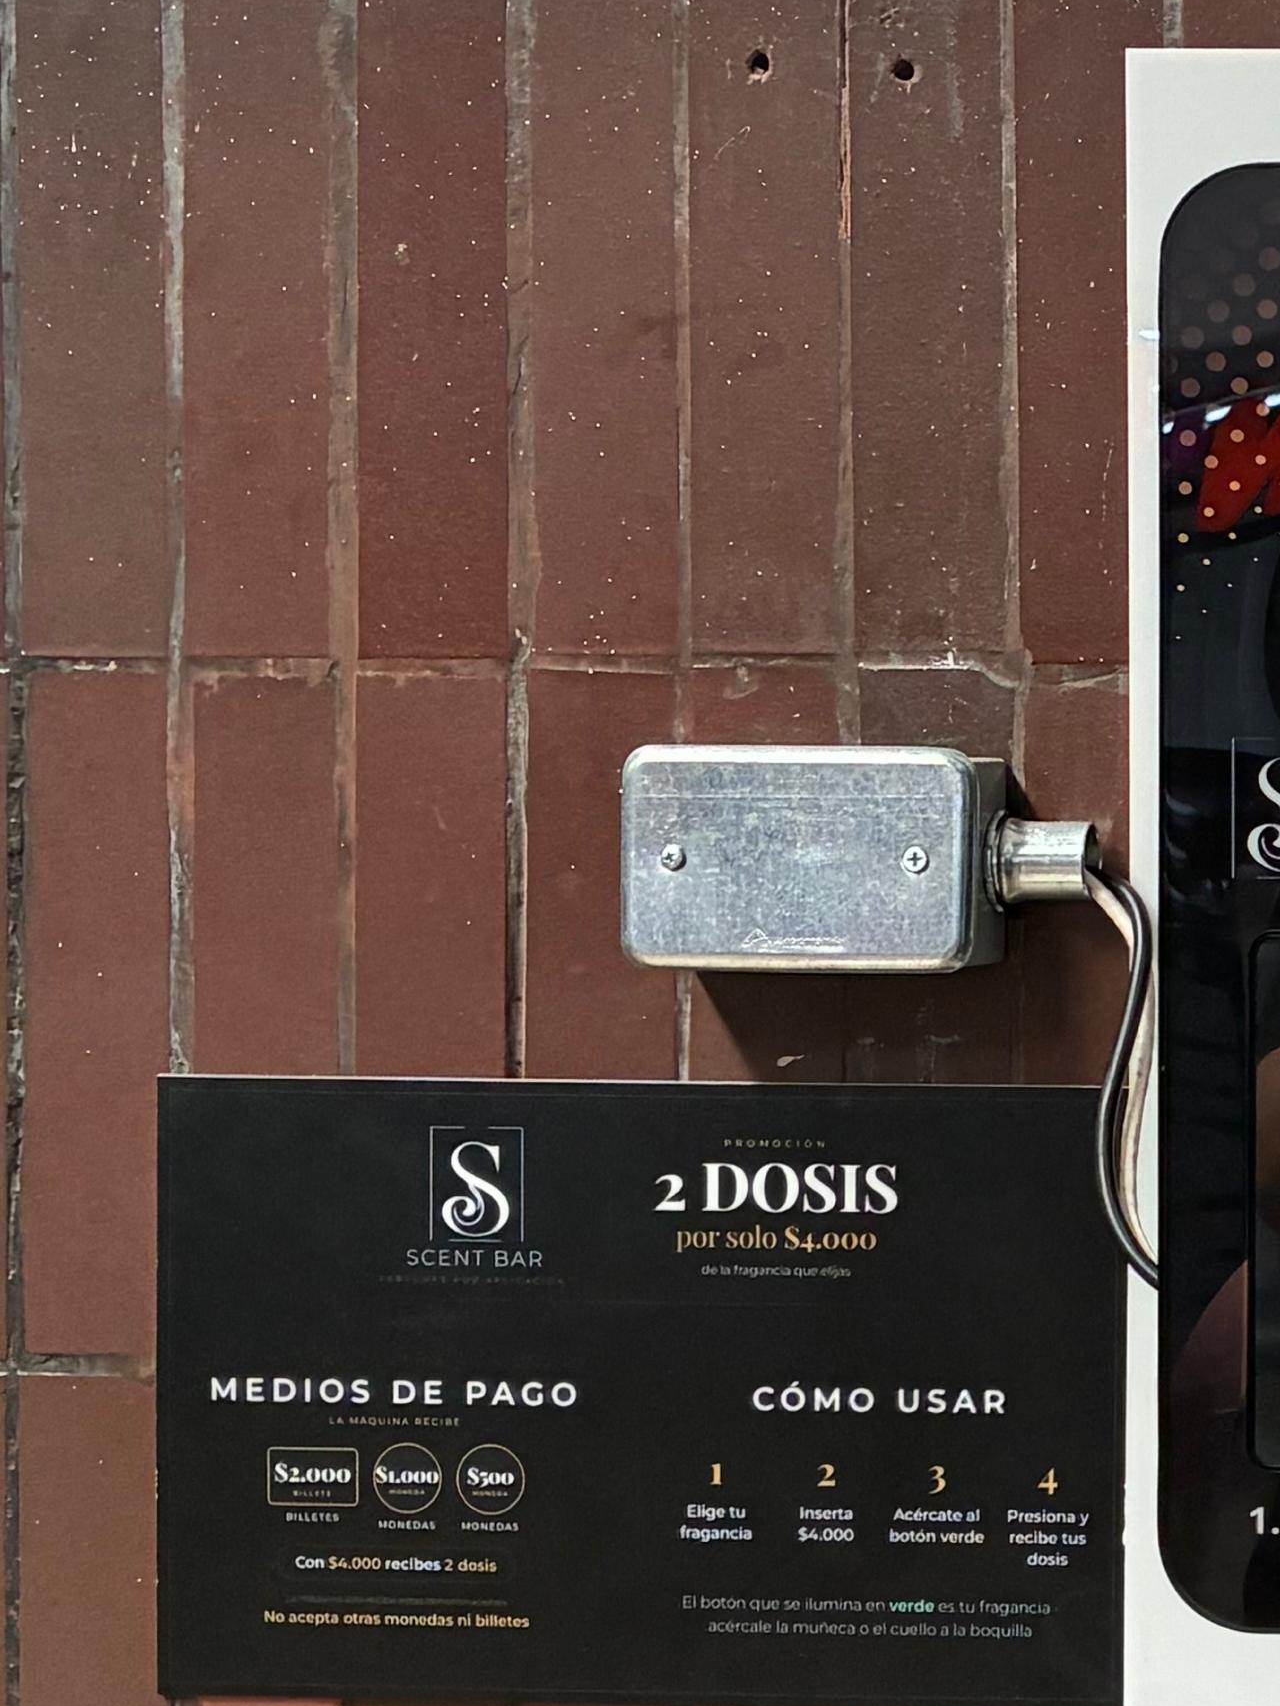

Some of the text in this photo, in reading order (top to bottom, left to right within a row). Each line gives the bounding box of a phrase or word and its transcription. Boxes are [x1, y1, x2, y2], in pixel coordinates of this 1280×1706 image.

[652, 1162, 899, 1214] 2 DOSIS
[675, 1224, 878, 1253] por solo $4.000
[406, 1249, 543, 1267] SCENT BAR
[210, 1377, 578, 1407] MEDIOS DE PAGO
[752, 1381, 1006, 1415] CÓMO USAR
[274, 1462, 351, 1484] $2.000
[376, 1465, 440, 1485] $1.000
[466, 1467, 515, 1489] $500
[710, 1463, 1059, 1495] 1 2 3 4
[686, 1503, 746, 1521] Elige tu
[800, 1506, 854, 1521] Inserta
[893, 1507, 980, 1522] Acércate al
[1007, 1509, 1090, 1527] Presiona y
[1250, 1507, 1280, 1535] 1.
[378, 1520, 436, 1531] MONEDAS
[461, 1521, 520, 1532] MONEDAS
[680, 1525, 753, 1543] fragancia
[798, 1526, 854, 1543] $4.000
[889, 1528, 985, 1544] botón verde
[1008, 1530, 1087, 1545] recibe tus
[295, 1556, 498, 1573] Con $4.000 recibes 2 dosis
[1026, 1551, 1068, 1567] dosis
[682, 1595, 696, 1609] El
[750, 1598, 780, 1612] que
[805, 1597, 862, 1612] ilumina
[866, 1601, 886, 1613] en
[889, 1599, 935, 1613] verde
[938, 1601, 955, 1613] es
[959, 1601, 976, 1614] tu
[979, 1599, 1050, 1617] fragancia
[264, 1611, 530, 1629] No acepta otras monedas ni billetes
